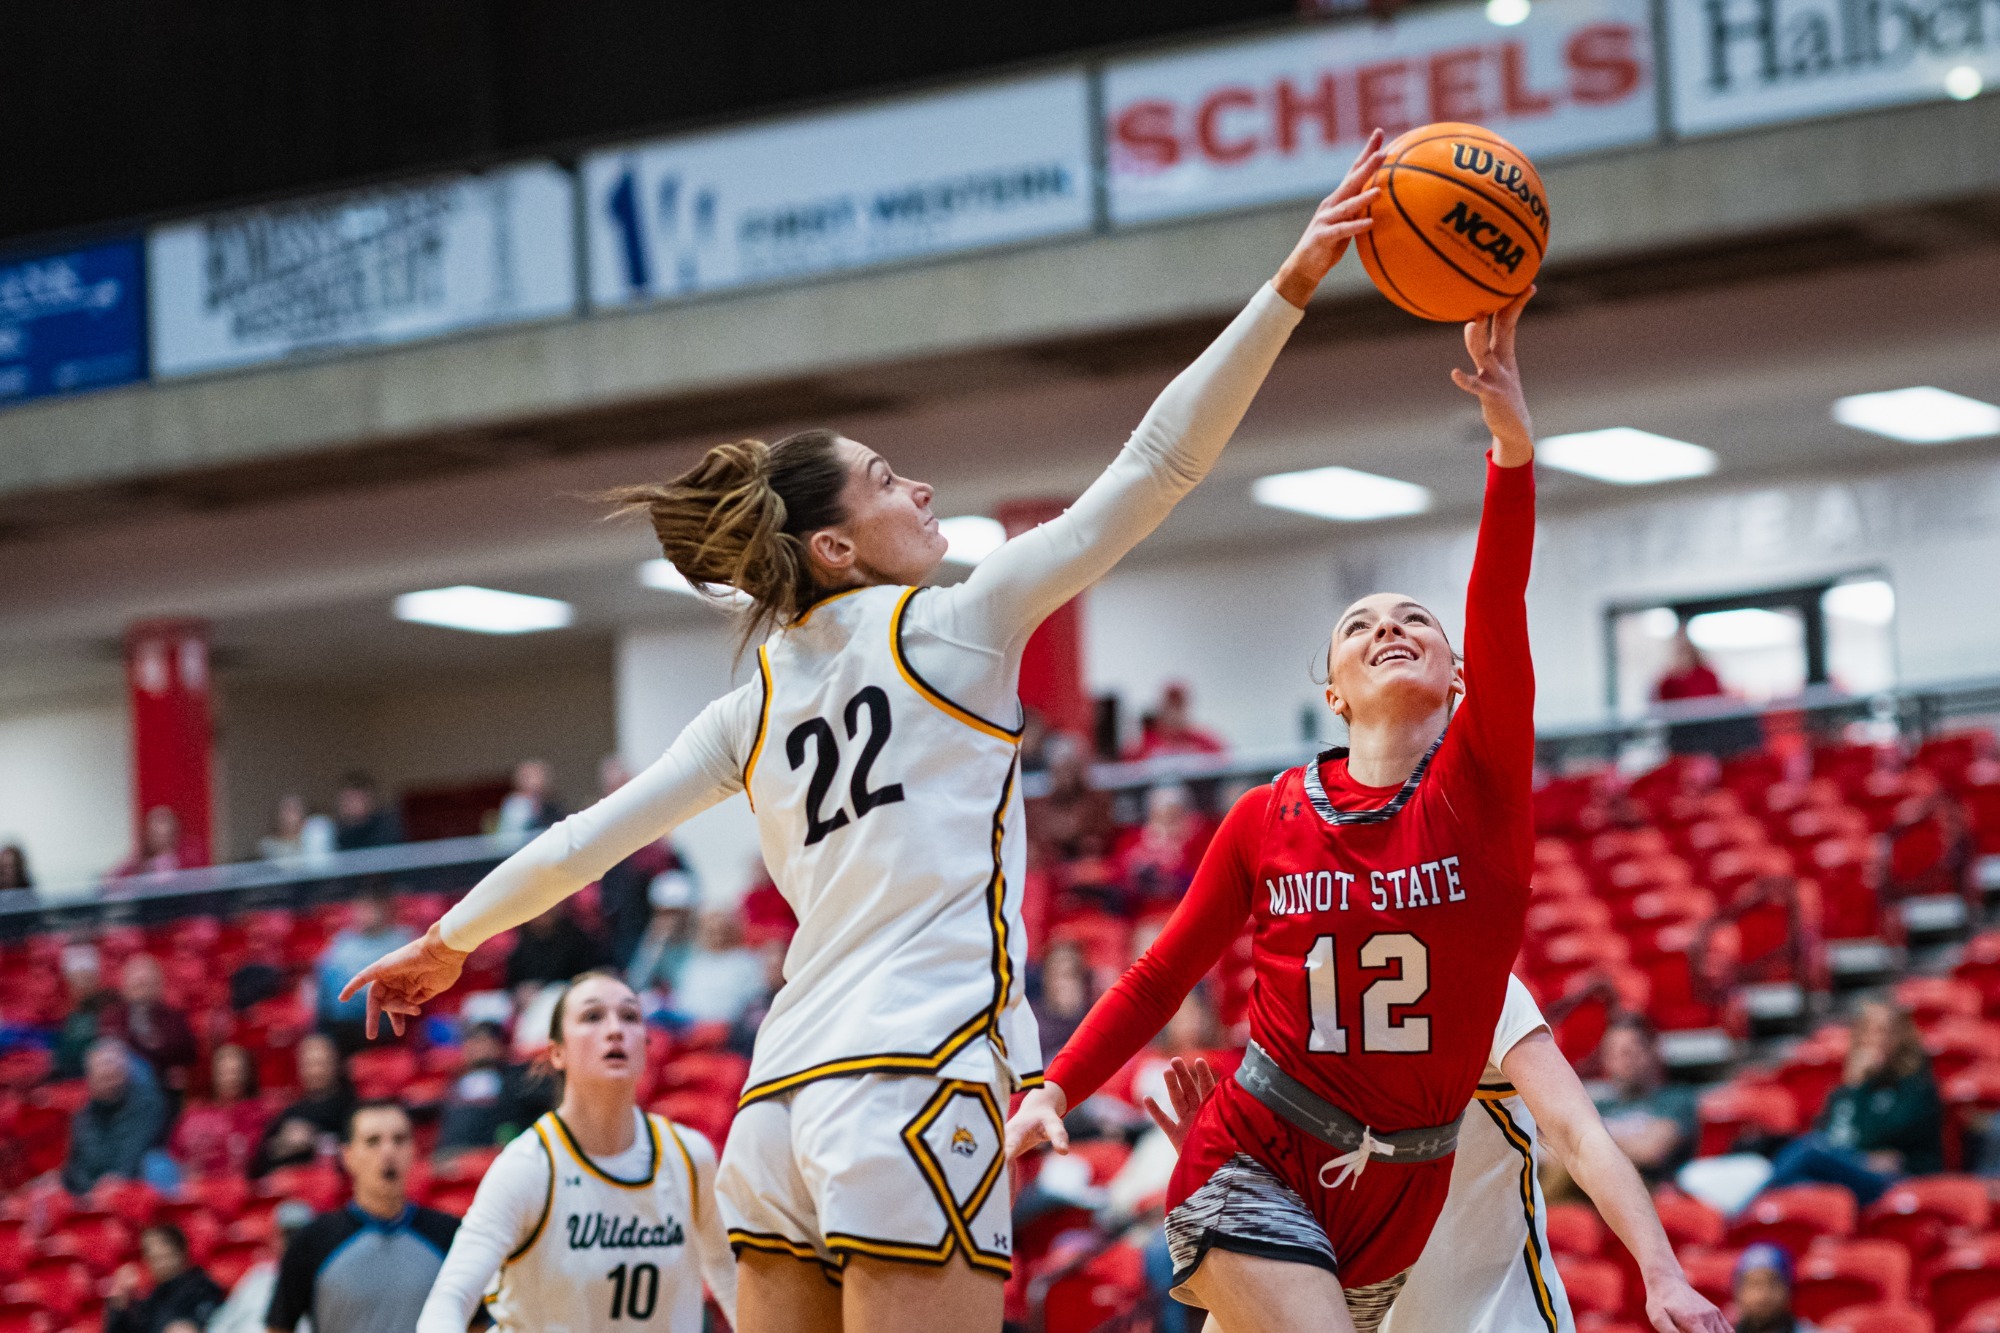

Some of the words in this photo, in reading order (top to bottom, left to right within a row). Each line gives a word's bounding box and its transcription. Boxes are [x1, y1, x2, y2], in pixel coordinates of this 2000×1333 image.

[1116, 22, 1640, 168] SCHEELS
[1451, 143, 1550, 236] Wilson
[1441, 201, 1526, 275] NCAA
[786, 685, 905, 847] 22
[1266, 869, 1356, 916] MINOT
[1370, 855, 1467, 913] STATE
[1303, 930, 1433, 1056] 12
[607, 1262, 660, 1321] 10
